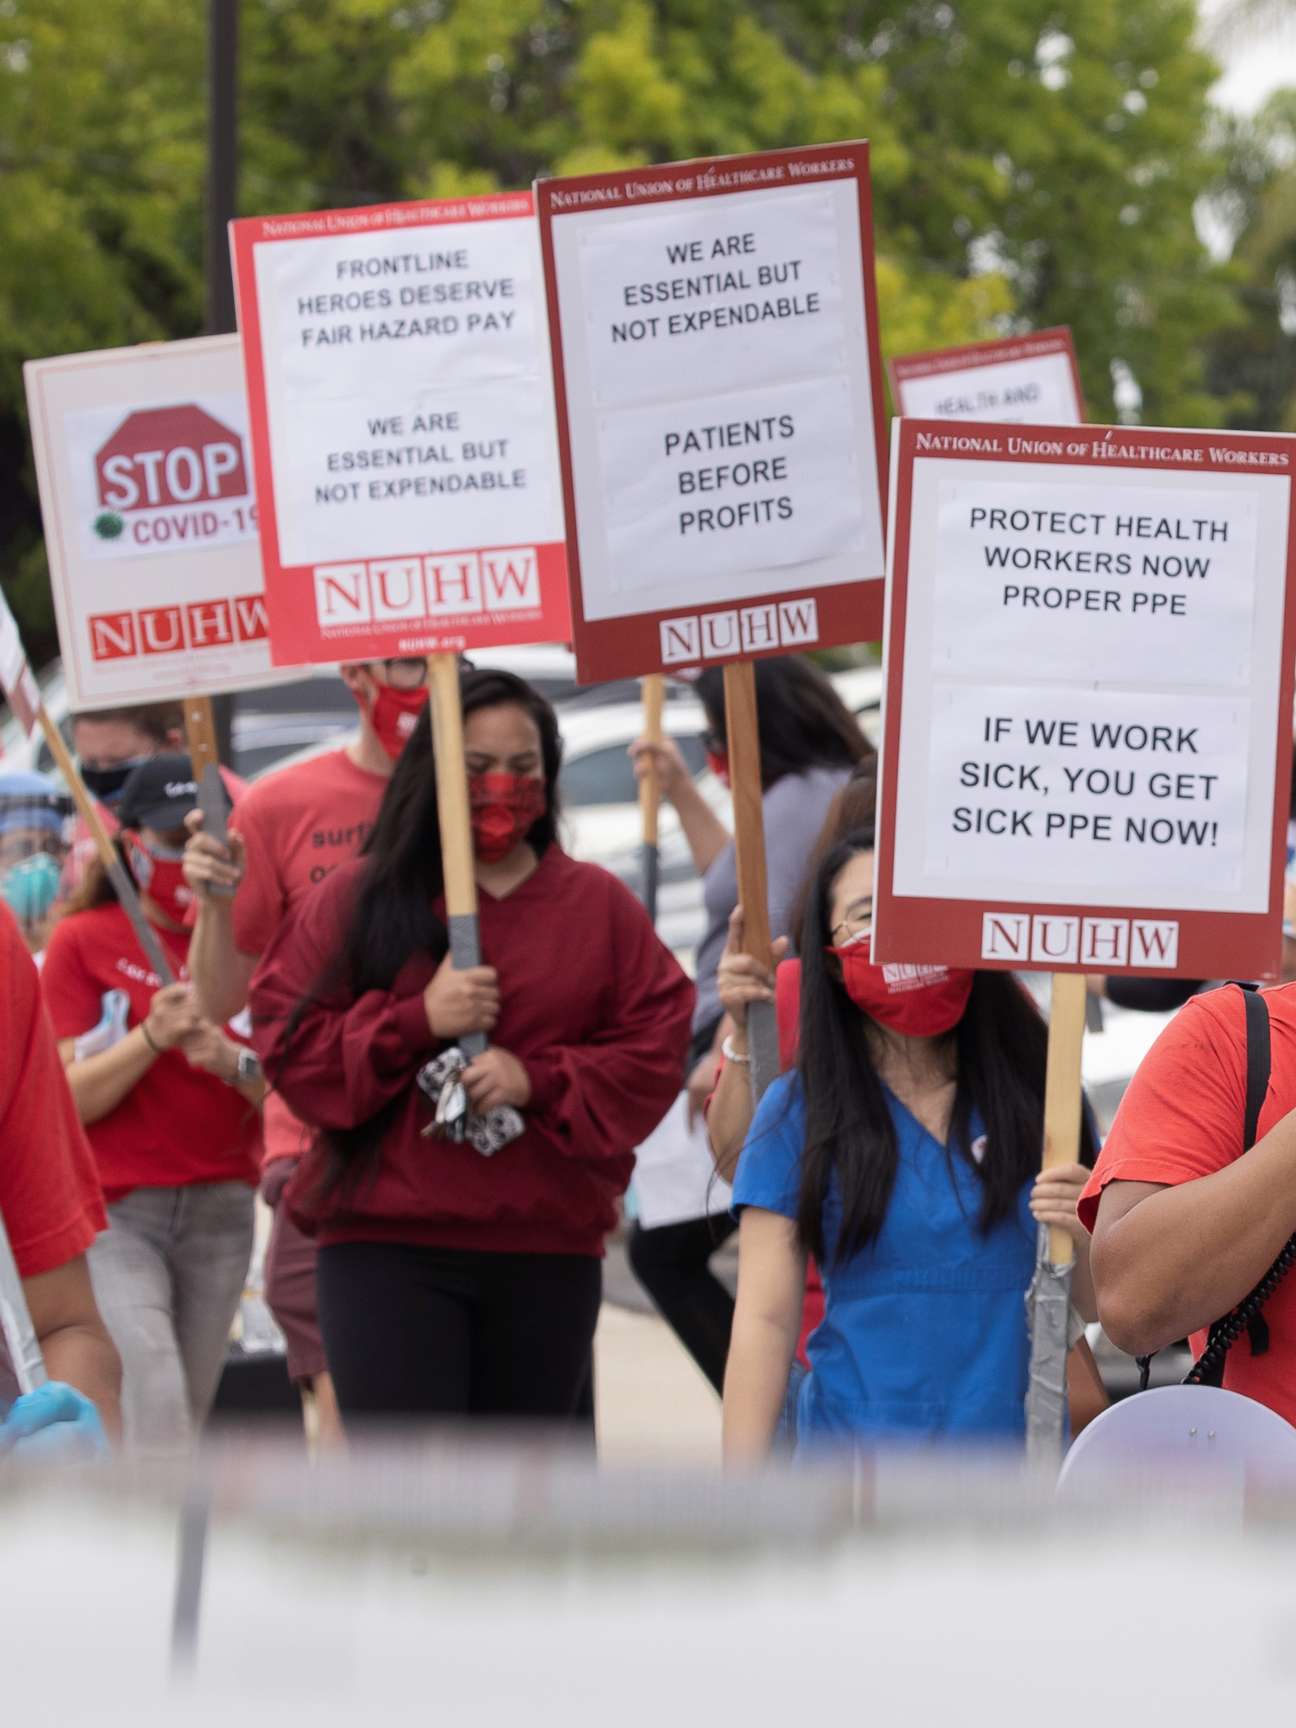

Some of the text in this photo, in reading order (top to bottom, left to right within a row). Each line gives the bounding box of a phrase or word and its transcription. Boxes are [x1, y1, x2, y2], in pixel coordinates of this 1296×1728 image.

[551, 188, 623, 210] NATIONAL
[625, 180, 673, 199] UNION
[696, 165, 784, 191] HEALTHCARE
[788, 158, 855, 176] WORKERS
[336, 249, 468, 279] FRONTLINE
[667, 233, 756, 264] WE ARE
[298, 278, 514, 316] HEROES DESERVE
[624, 261, 801, 306] ESSENTIAL BUT
[301, 311, 515, 347] FAIR HAZARD PAY
[611, 292, 820, 343] NOT EXPENDABLE
[367, 411, 460, 436] WE ARE
[665, 415, 795, 456] PATIENTS
[327, 439, 509, 472] ESSENTIAL BUT
[916, 432, 1290, 467] NATIONAL UNION OF HEALTHCARE WORKERS
[102, 441, 239, 509] STOP
[315, 468, 527, 503] NOT EXPENDABLE
[678, 457, 788, 495] BEFORE
[679, 496, 793, 535] PROFITS
[970, 507, 1229, 542] PROTECT HEALTH
[984, 545, 1210, 579] WORKERS NOW
[322, 557, 532, 615] NUHW
[1003, 584, 1187, 615] PROPER PPE
[664, 601, 813, 658] NUHW
[983, 717, 1200, 754] IF WE WORK
[960, 761, 1219, 801] SICK, YOU GET
[952, 806, 1219, 847] SICK PPE NOW!
[987, 917, 1176, 960] NUHW
